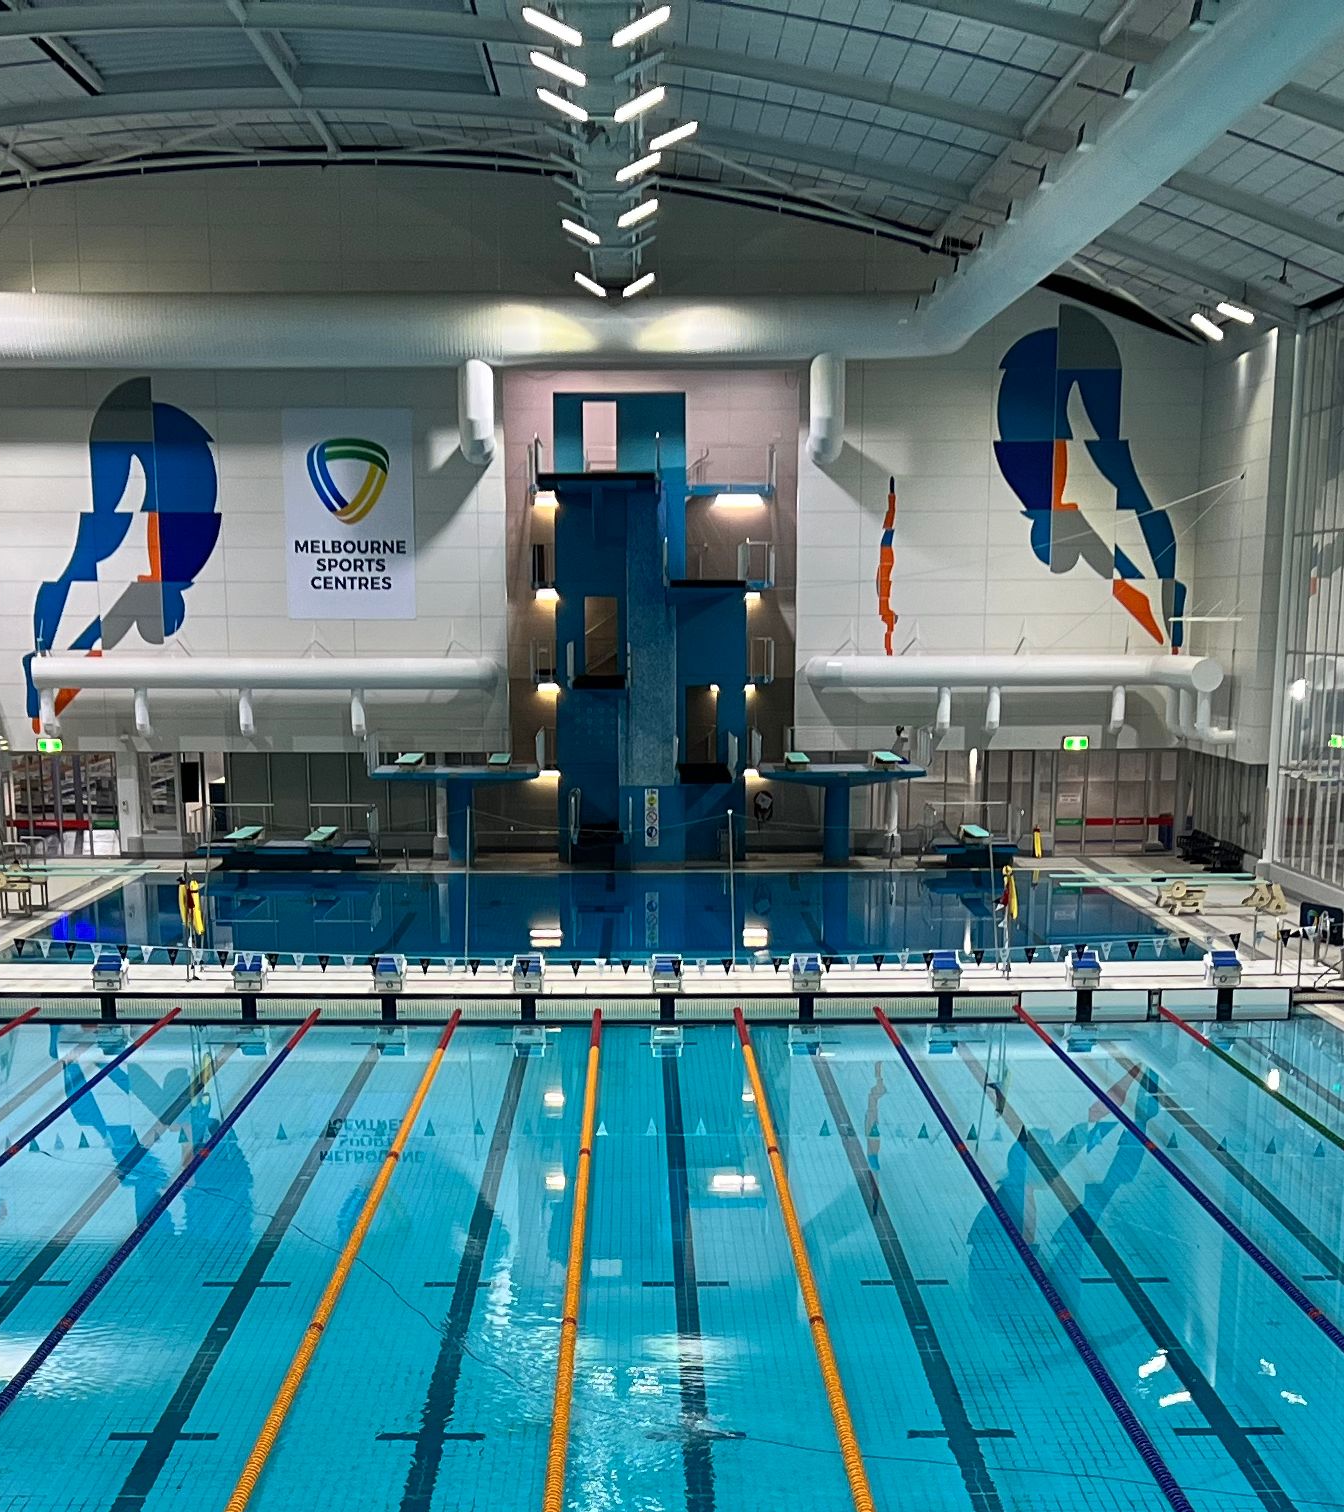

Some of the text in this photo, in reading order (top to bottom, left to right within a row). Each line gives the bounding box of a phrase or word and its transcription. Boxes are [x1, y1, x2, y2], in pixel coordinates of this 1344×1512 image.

[294, 540, 407, 554] MELBOURNE
[316, 558, 386, 572] SPORTS
[310, 576, 392, 590] CENTRES
